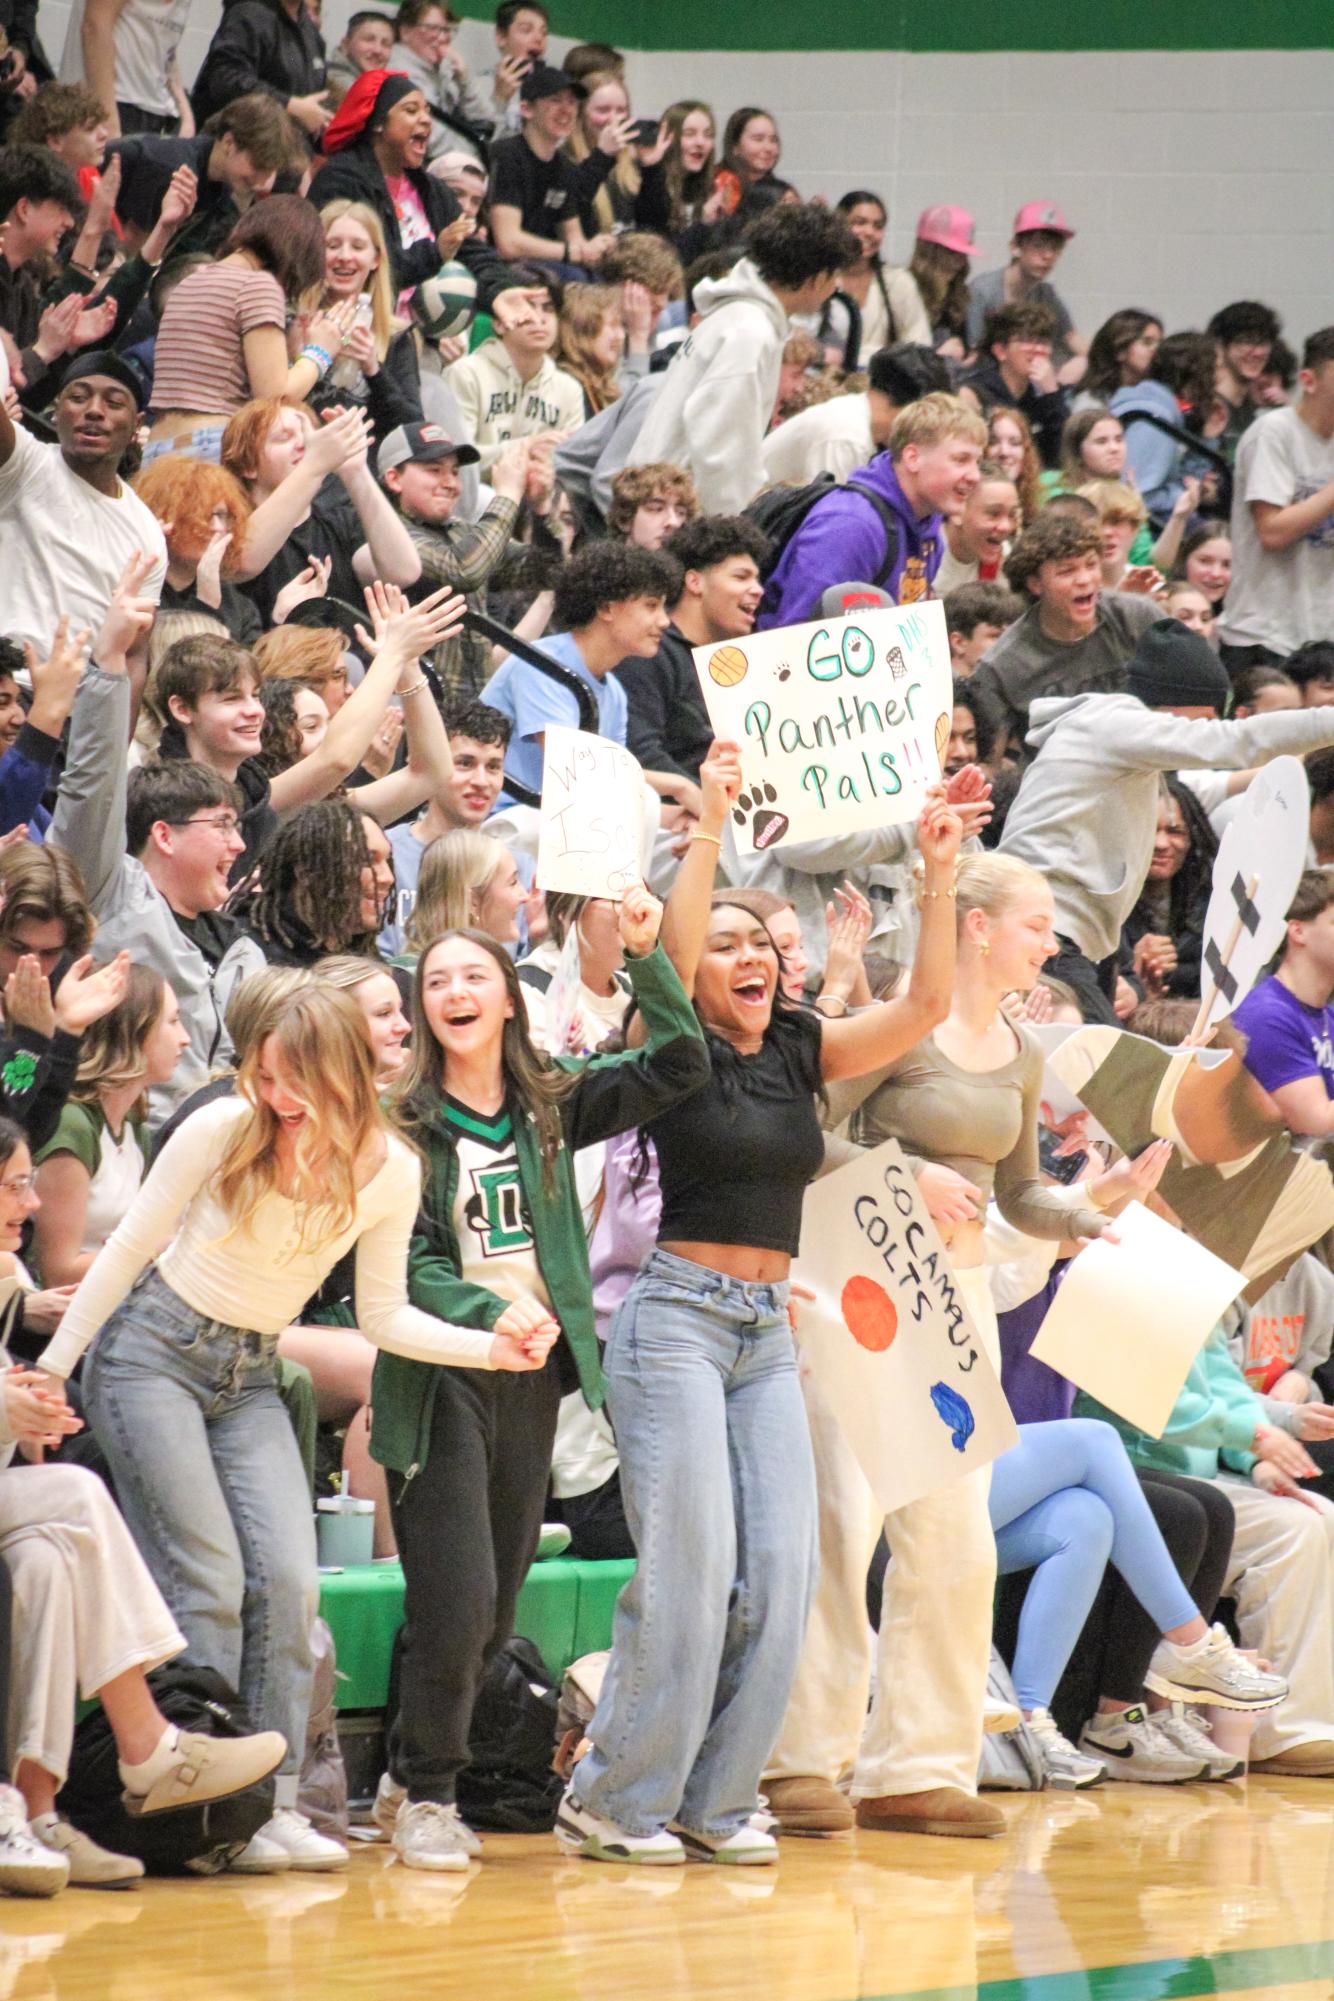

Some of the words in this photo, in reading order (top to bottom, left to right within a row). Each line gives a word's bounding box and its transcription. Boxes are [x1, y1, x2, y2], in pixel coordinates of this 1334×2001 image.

[807, 626, 875, 681] GO
[745, 683, 921, 758] Panther
[549, 746, 597, 793] Way
[854, 1195, 933, 1322] COLTS
[884, 1165, 913, 1217] GO
[905, 1221, 978, 1372] CAMPUS
